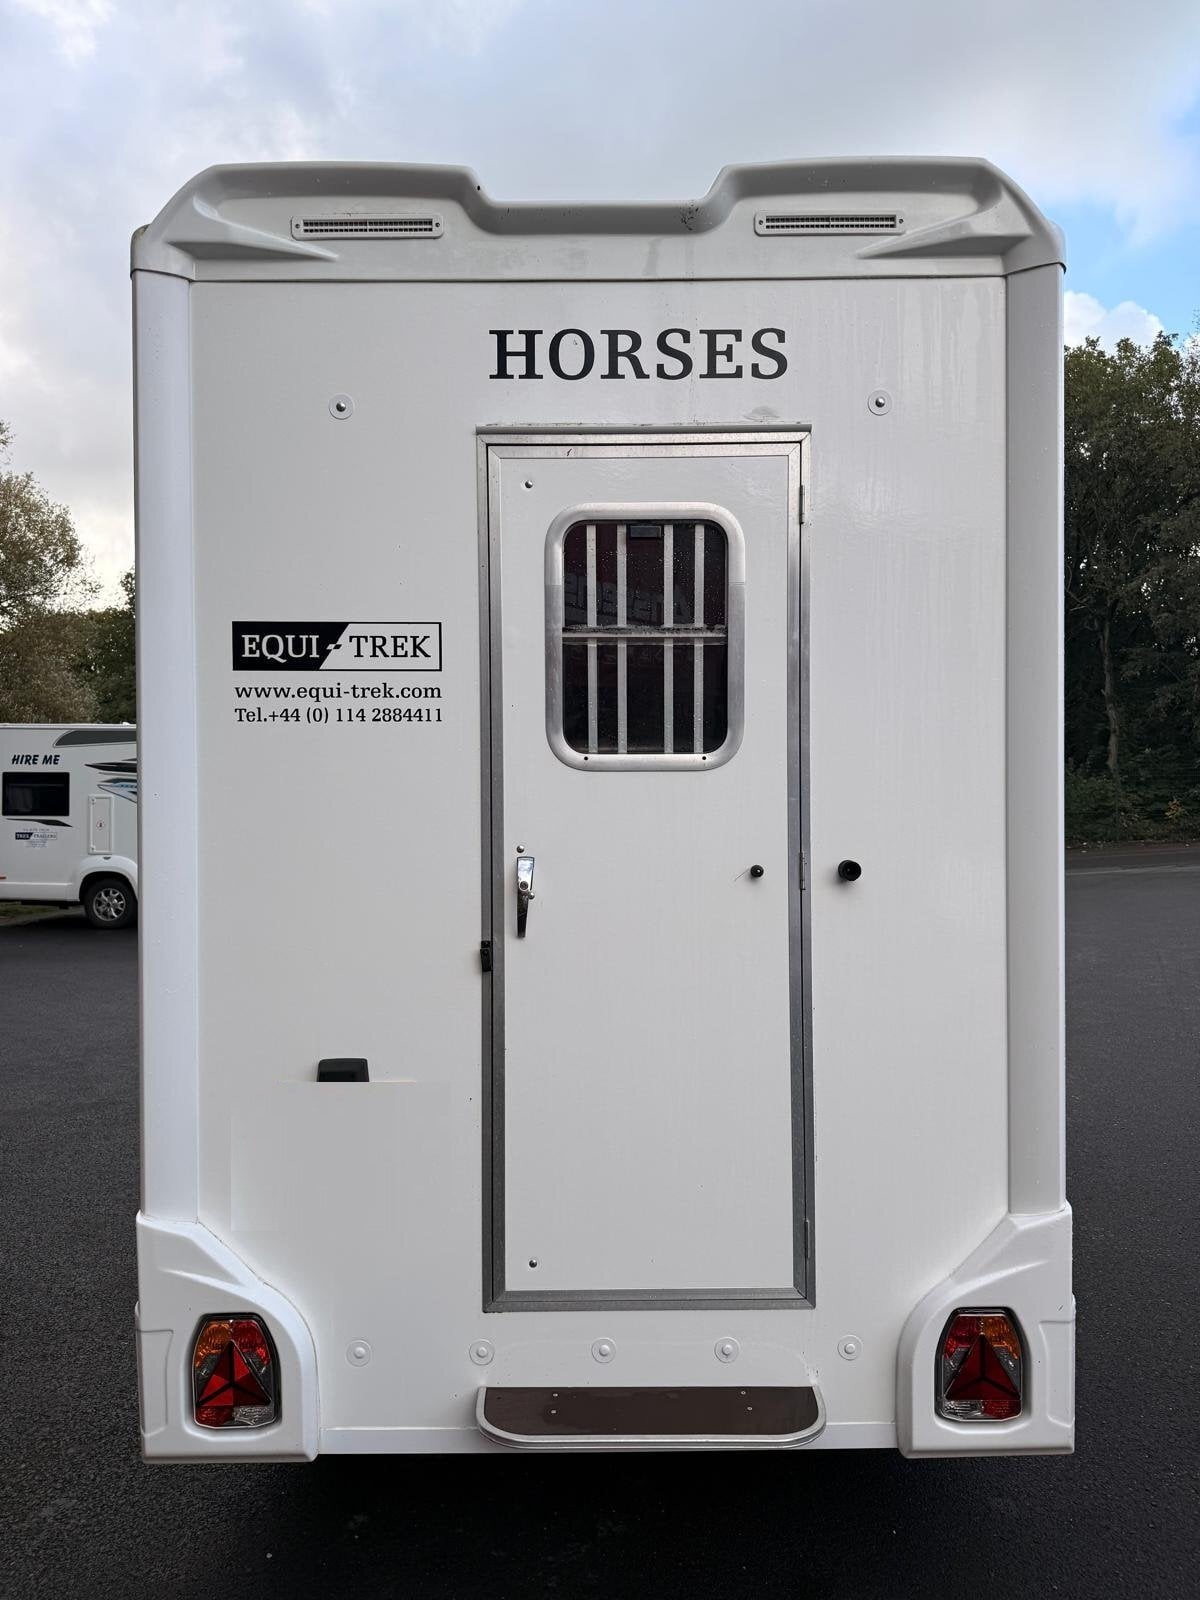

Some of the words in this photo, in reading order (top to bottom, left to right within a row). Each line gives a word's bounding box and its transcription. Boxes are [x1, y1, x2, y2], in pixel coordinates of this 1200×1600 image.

[488, 327, 788, 381] HORSES
[241, 634, 432, 663] EQUI-TREK
[234, 682, 443, 703] www.equi-trek.com
[234, 706, 301, 723] Tel.+44
[306, 706, 330, 724] (0)
[335, 707, 367, 722] 114
[371, 707, 443, 722] 2884411
[11, 754, 40, 766] HIRE
[42, 754, 61, 766] ME
